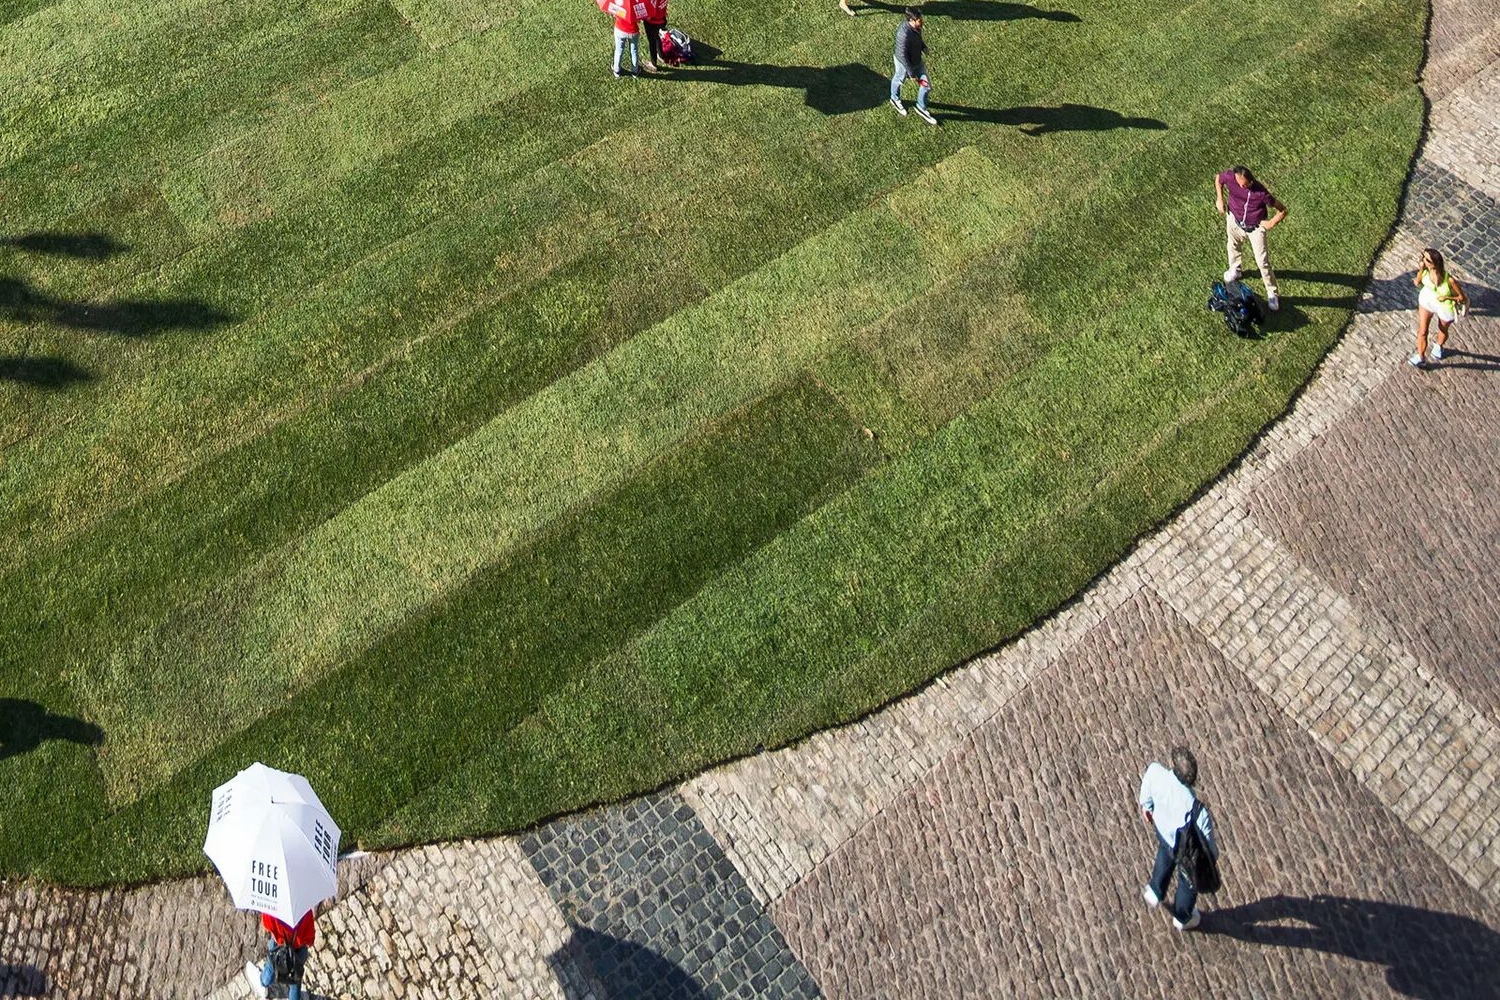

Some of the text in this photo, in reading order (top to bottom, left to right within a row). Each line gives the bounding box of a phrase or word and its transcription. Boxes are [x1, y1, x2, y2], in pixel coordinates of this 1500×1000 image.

[315, 819, 323, 854] FREE
[323, 830, 331, 864] TOUR
[252, 860, 278, 880] FREE
[252, 878, 278, 898] TOUR
